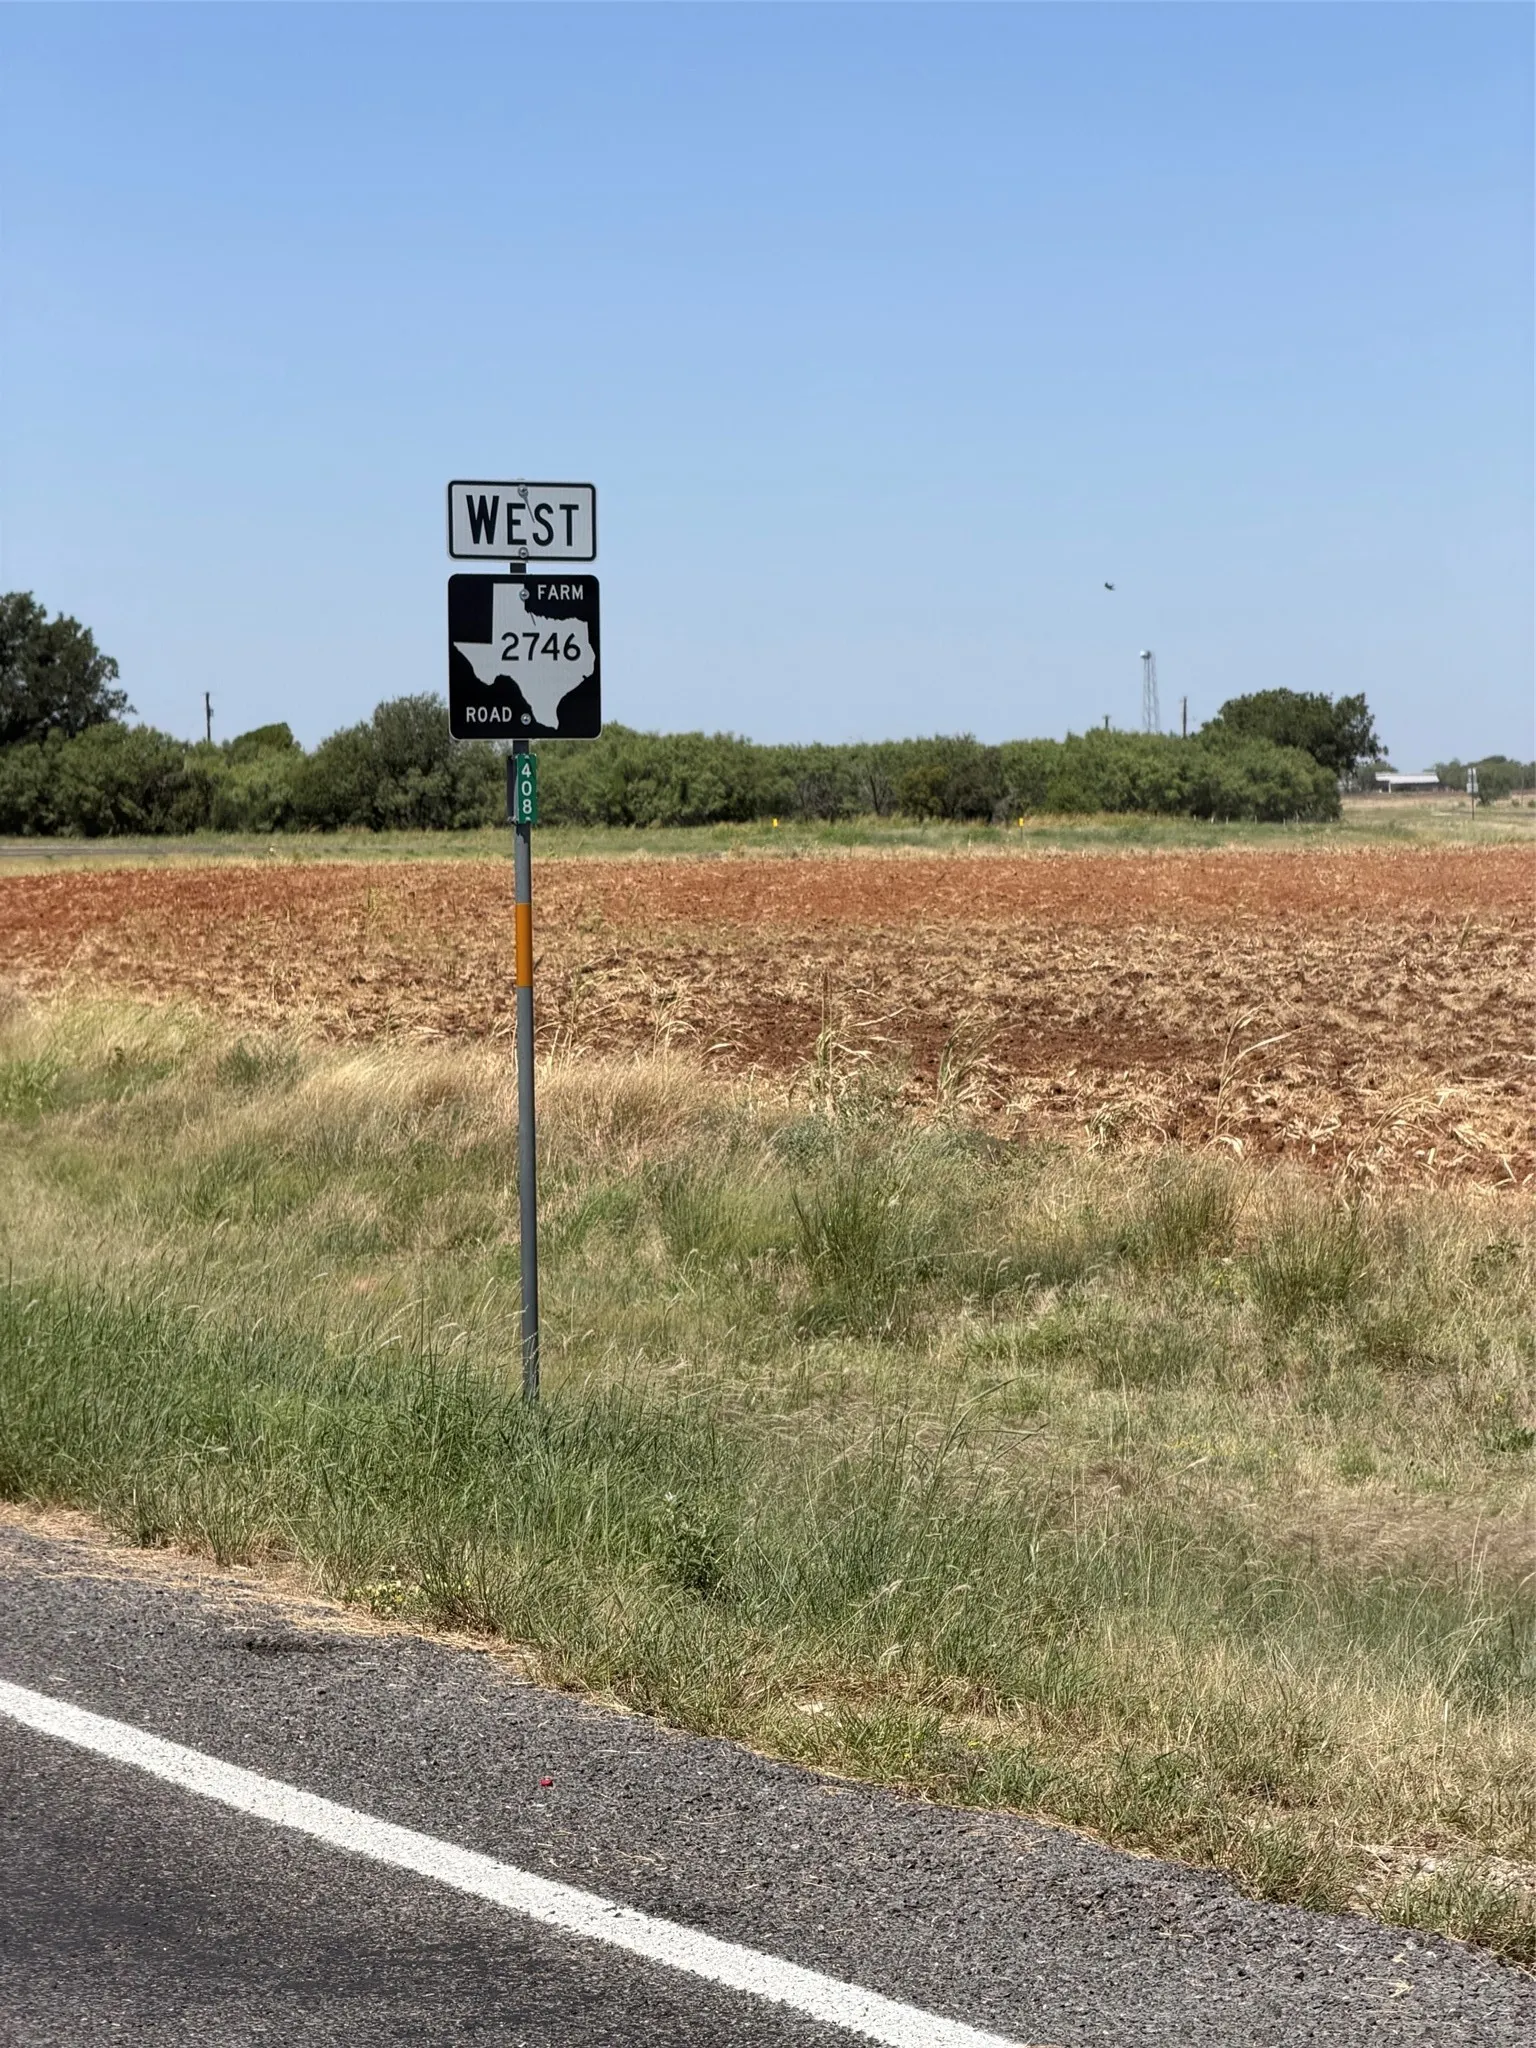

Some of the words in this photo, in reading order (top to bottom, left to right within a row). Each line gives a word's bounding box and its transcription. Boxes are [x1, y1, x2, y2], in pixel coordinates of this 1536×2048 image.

[466, 494, 579, 547] WEST
[537, 584, 584, 601] FARM
[501, 631, 581, 661] 2746
[466, 706, 512, 723] ROAD
[521, 764, 532, 814] 408
